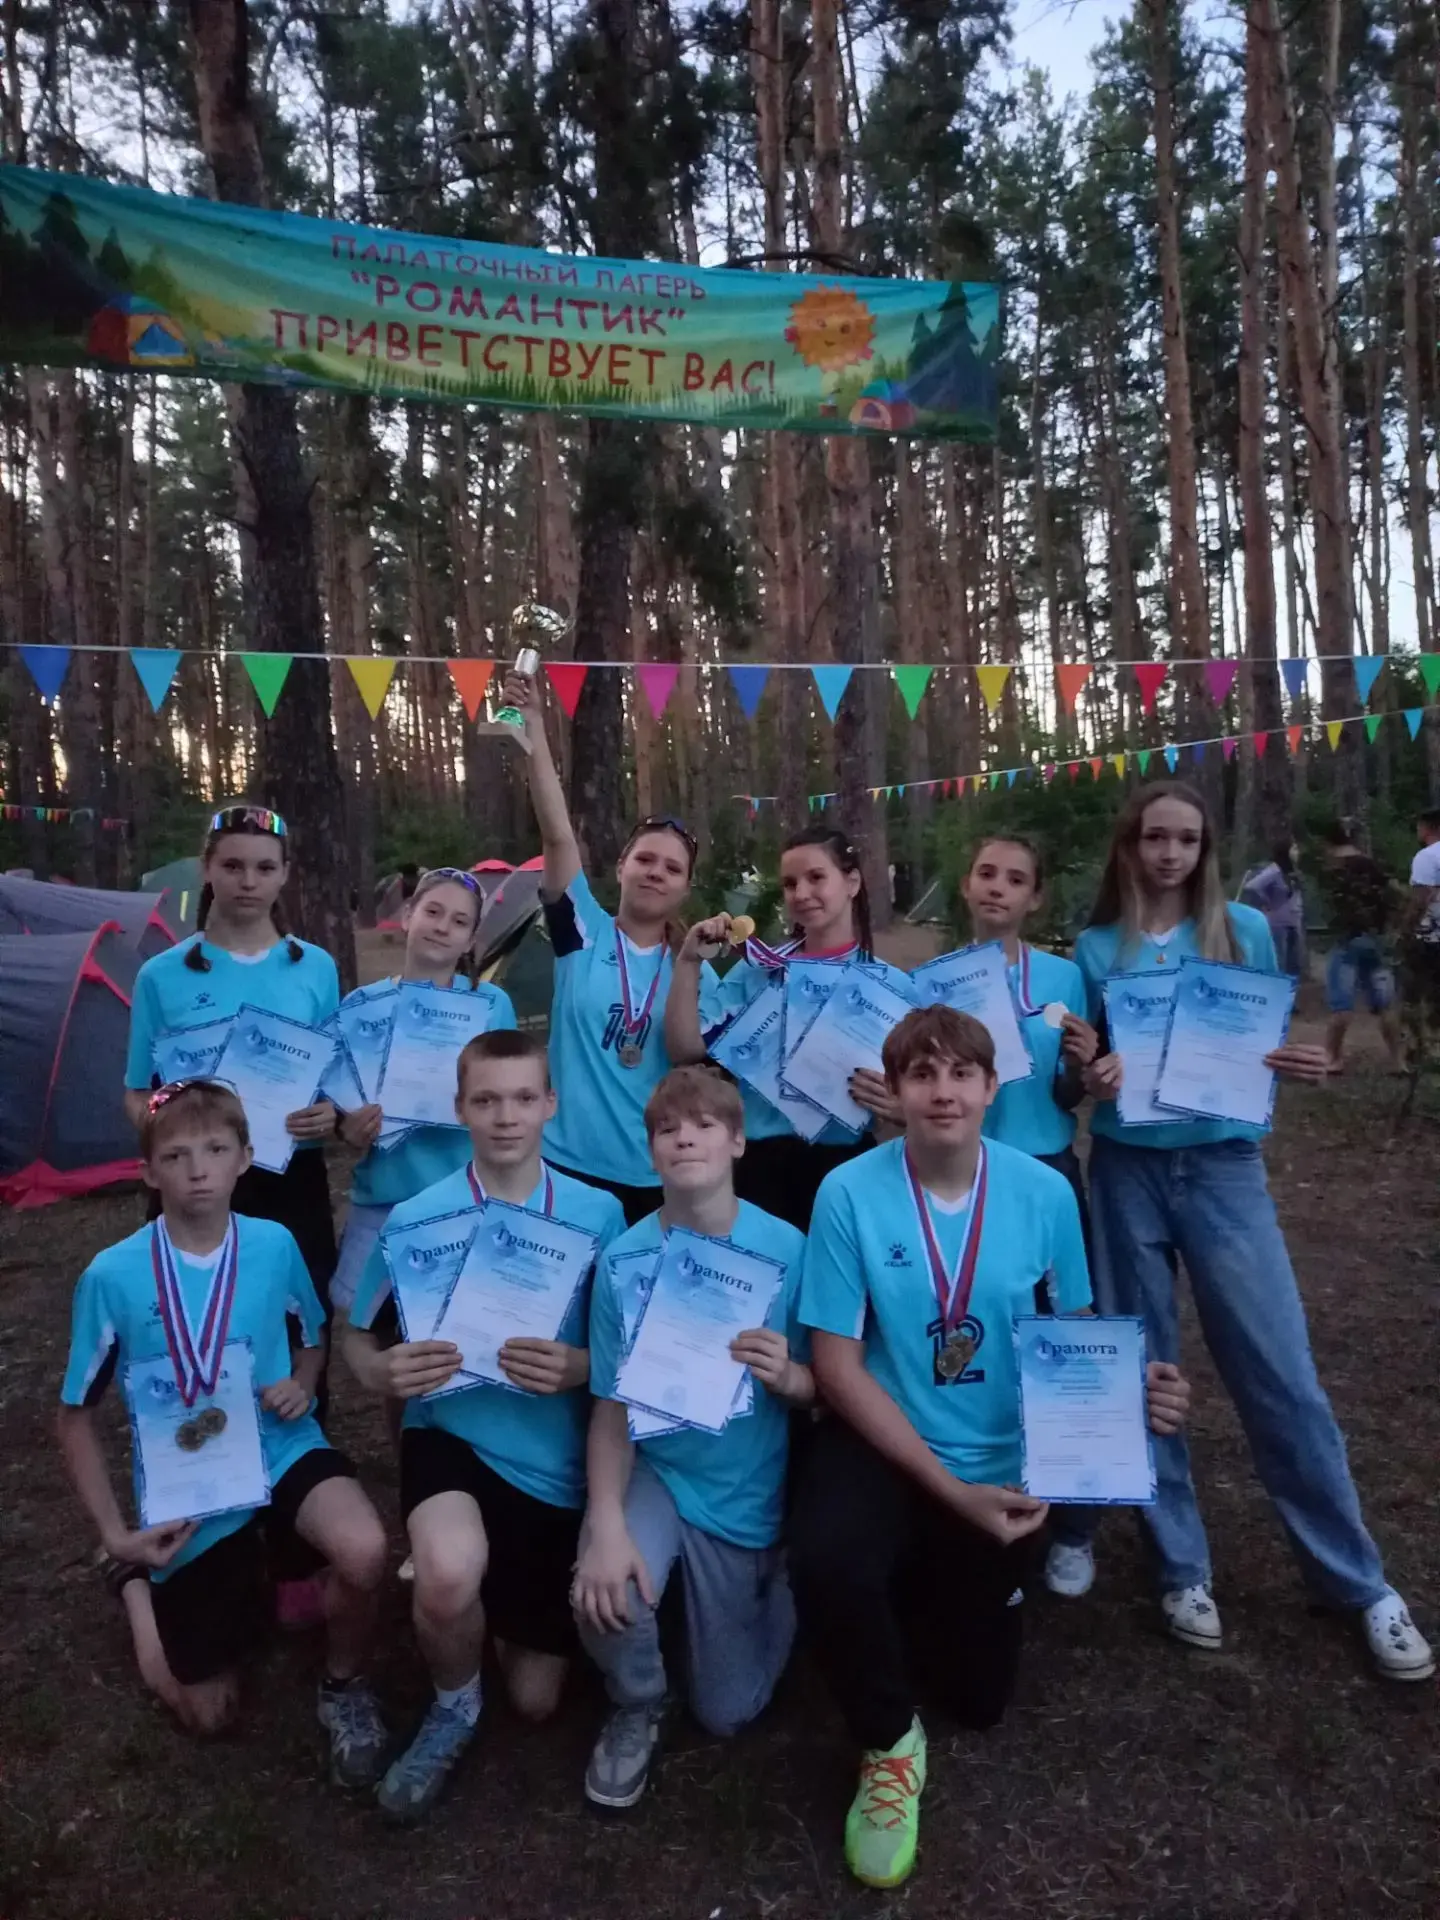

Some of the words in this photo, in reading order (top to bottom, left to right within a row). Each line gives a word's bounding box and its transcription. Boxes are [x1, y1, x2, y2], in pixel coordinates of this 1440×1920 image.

[331, 235, 579, 284] ПАЛАТОЧНЫЙ
[596, 271, 706, 300] ЛАГЕРЬ
[270, 309, 666, 385] ПРИВЕТСТВУЕТ
[683, 353, 776, 394] ВАС!
[851, 989, 898, 1025] Грамот
[1199, 980, 1268, 1006] Грамота
[413, 1004, 471, 1022] Грамота
[251, 1029, 311, 1061] Грамота
[736, 1010, 780, 1056] Грамота
[409, 1238, 470, 1264] Грамо
[498, 1228, 567, 1262] Грамота
[683, 1256, 753, 1293] Грамота
[926, 1314, 985, 1386] 12
[1040, 1340, 1118, 1357] Грамота
